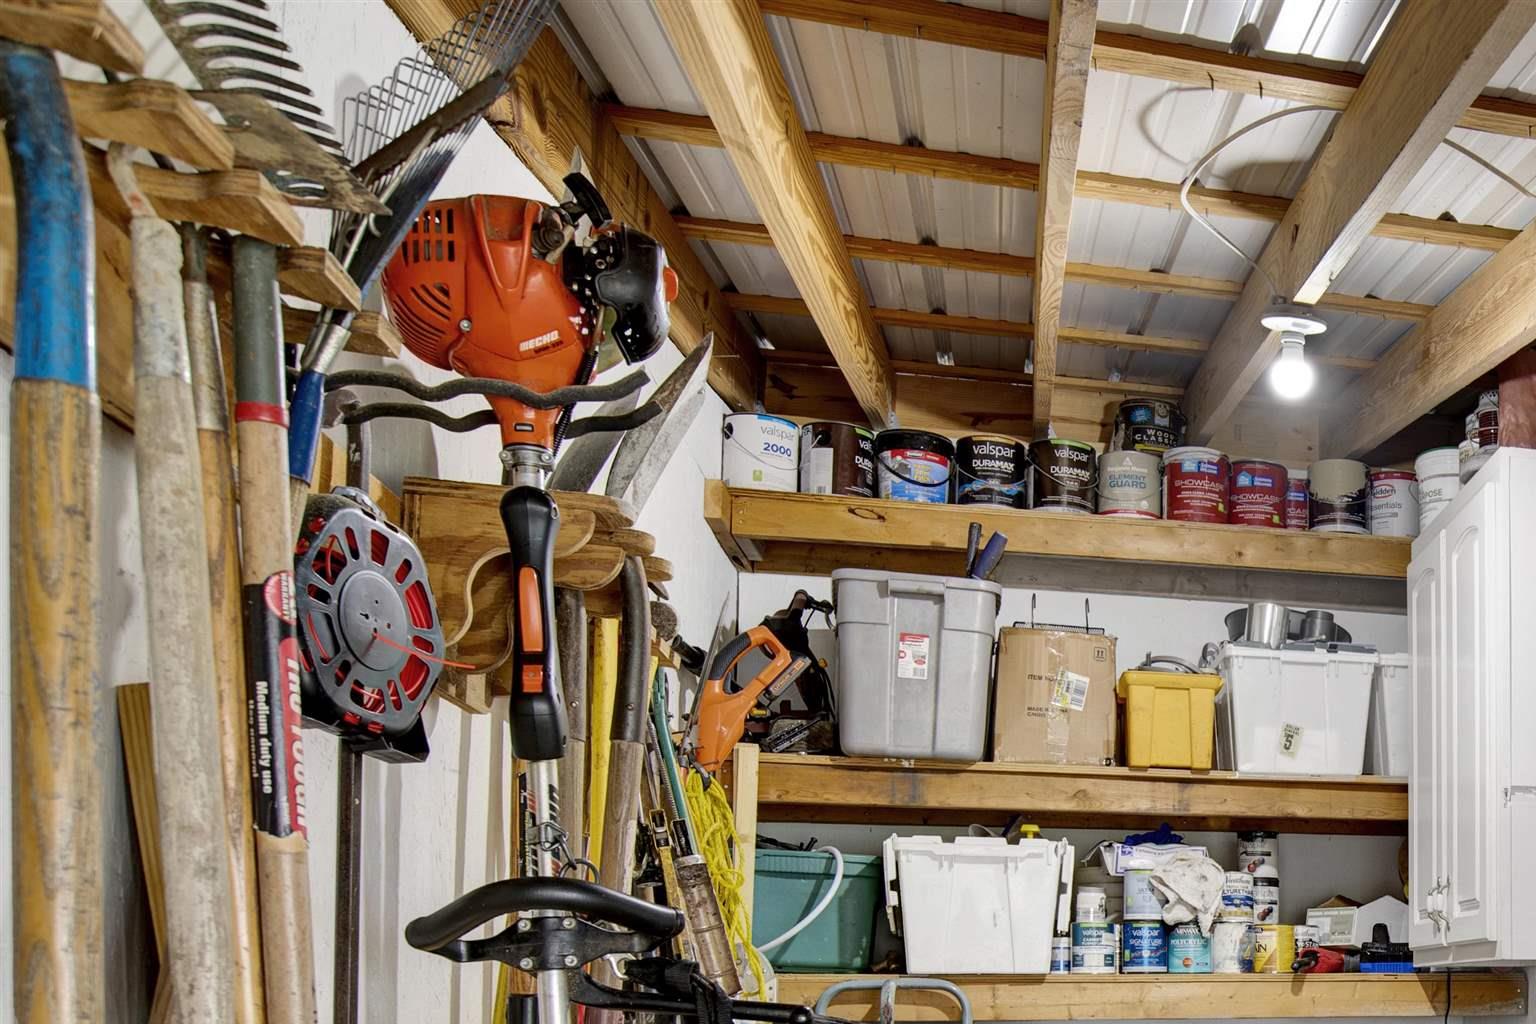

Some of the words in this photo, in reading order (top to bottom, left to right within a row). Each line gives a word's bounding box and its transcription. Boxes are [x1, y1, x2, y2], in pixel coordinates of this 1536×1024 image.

[528, 330, 559, 349] ECHO
[760, 425, 795, 441] valspar
[1146, 428, 1174, 440] WOOD
[763, 442, 791, 457] 2000
[972, 442, 1016, 458] valspar
[1054, 447, 1089, 462] valspar
[972, 459, 1015, 472] DURAMAX
[1050, 465, 1090, 479] DURAMAX
[1109, 480, 1147, 489] GUARD
[1027, 673, 1043, 681] ITEM
[255, 681, 269, 735] Medium
[260, 737, 272, 768] duty
[262, 770, 273, 794] use
[1082, 927, 1105, 936] valspar
[1132, 927, 1160, 937] valspar
